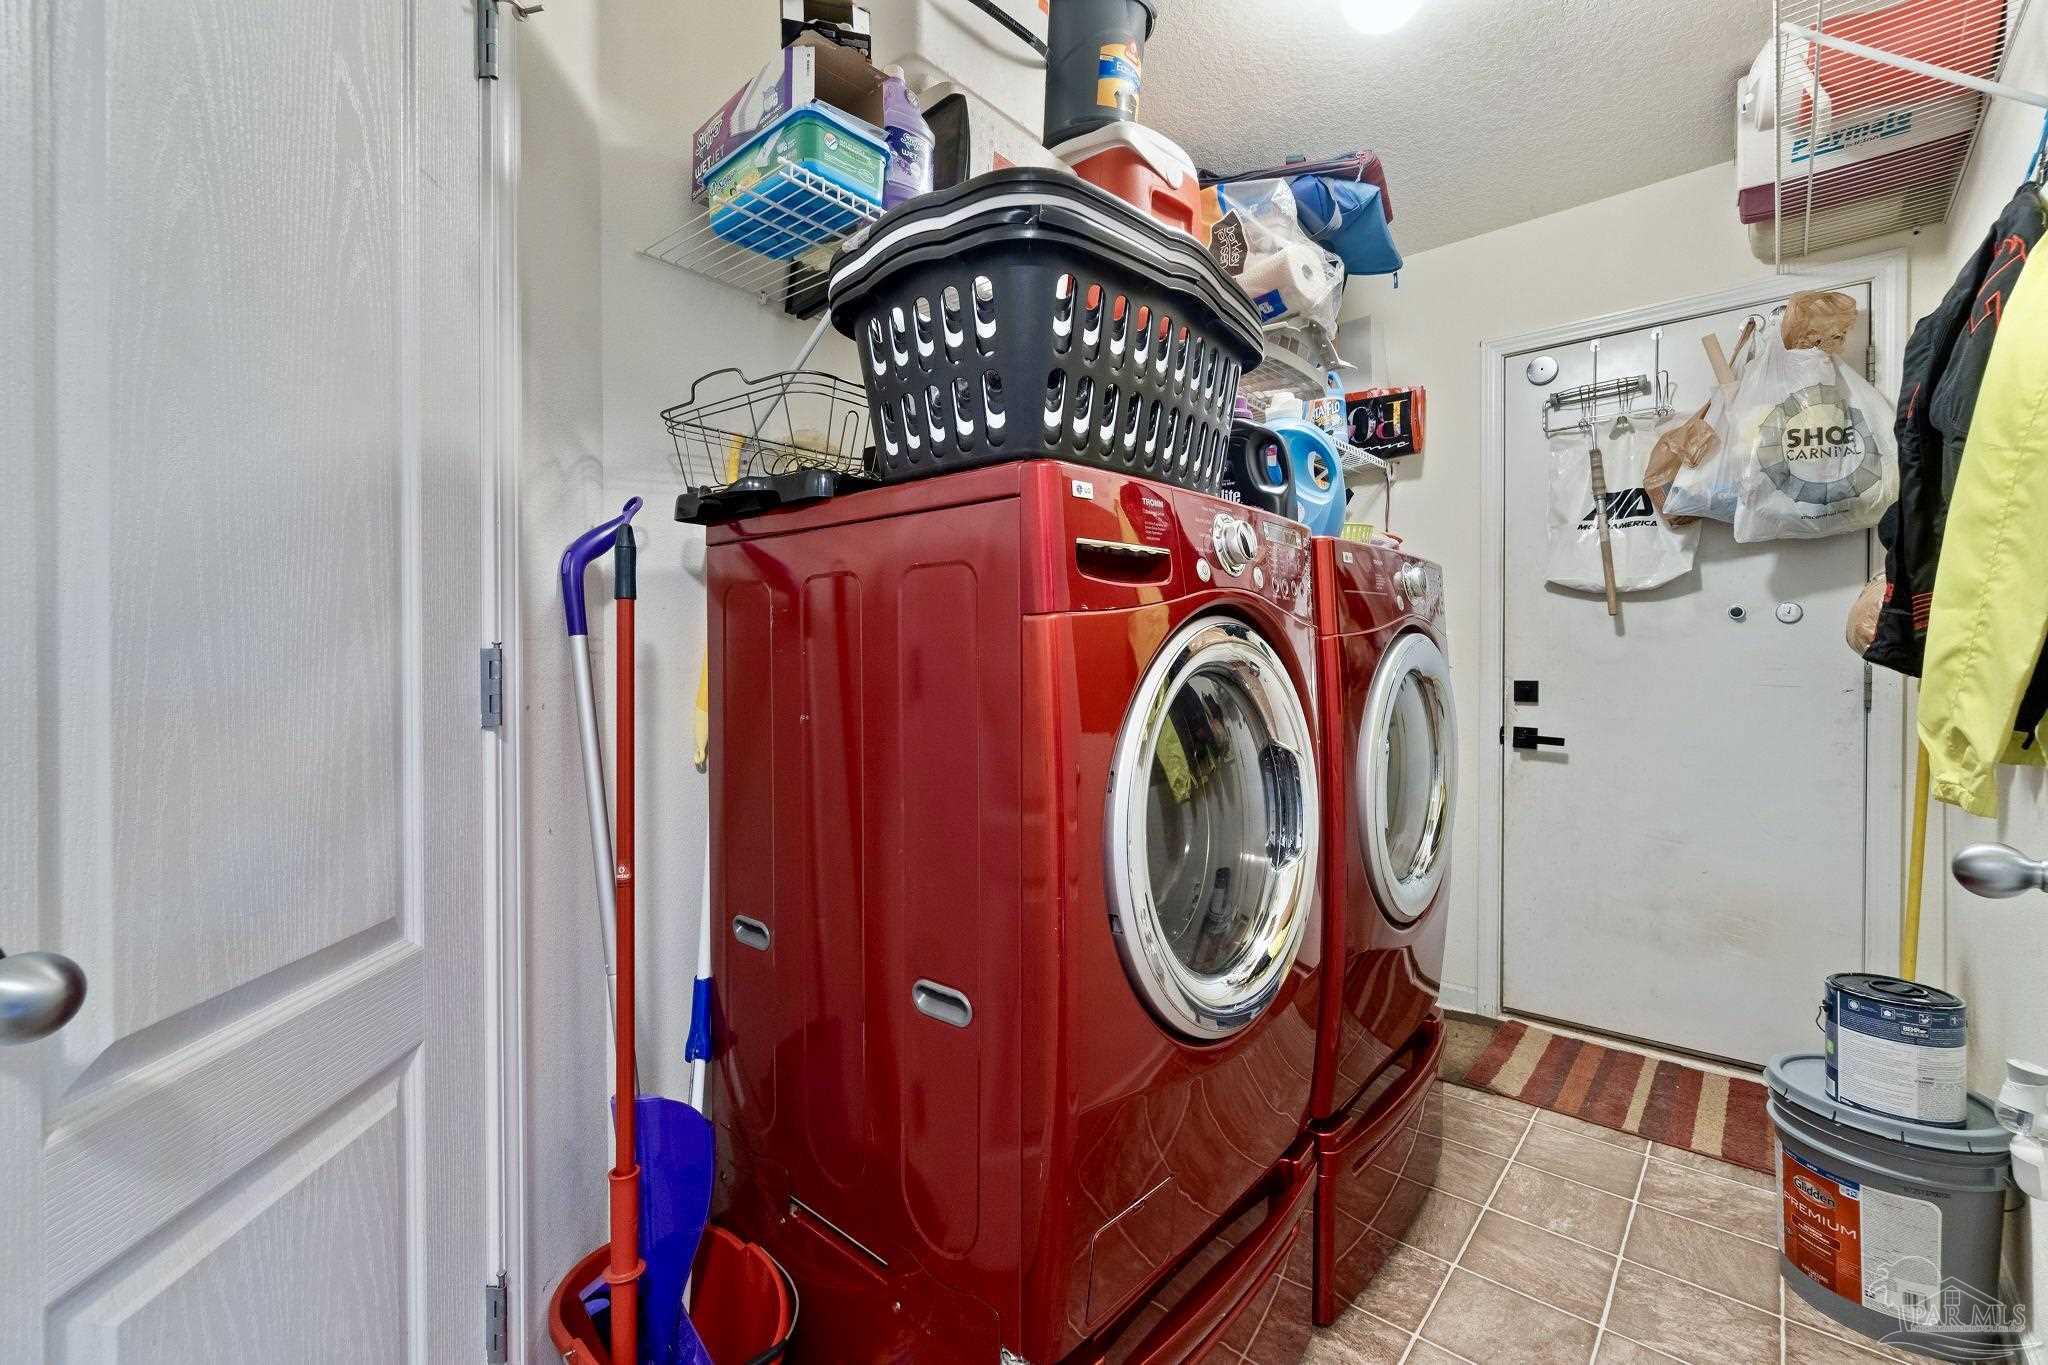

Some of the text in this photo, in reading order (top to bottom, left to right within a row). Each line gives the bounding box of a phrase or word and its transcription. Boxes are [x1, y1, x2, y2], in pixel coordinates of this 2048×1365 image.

[1213, 227, 1230, 270] jensen
[1226, 223, 1243, 267] berkley
[1786, 425, 1856, 448] SHOE
[1786, 446, 1862, 462] CARNIAL
[1793, 1177, 1835, 1207] Glidden
[1783, 1190, 1857, 1240] PREMIUM
